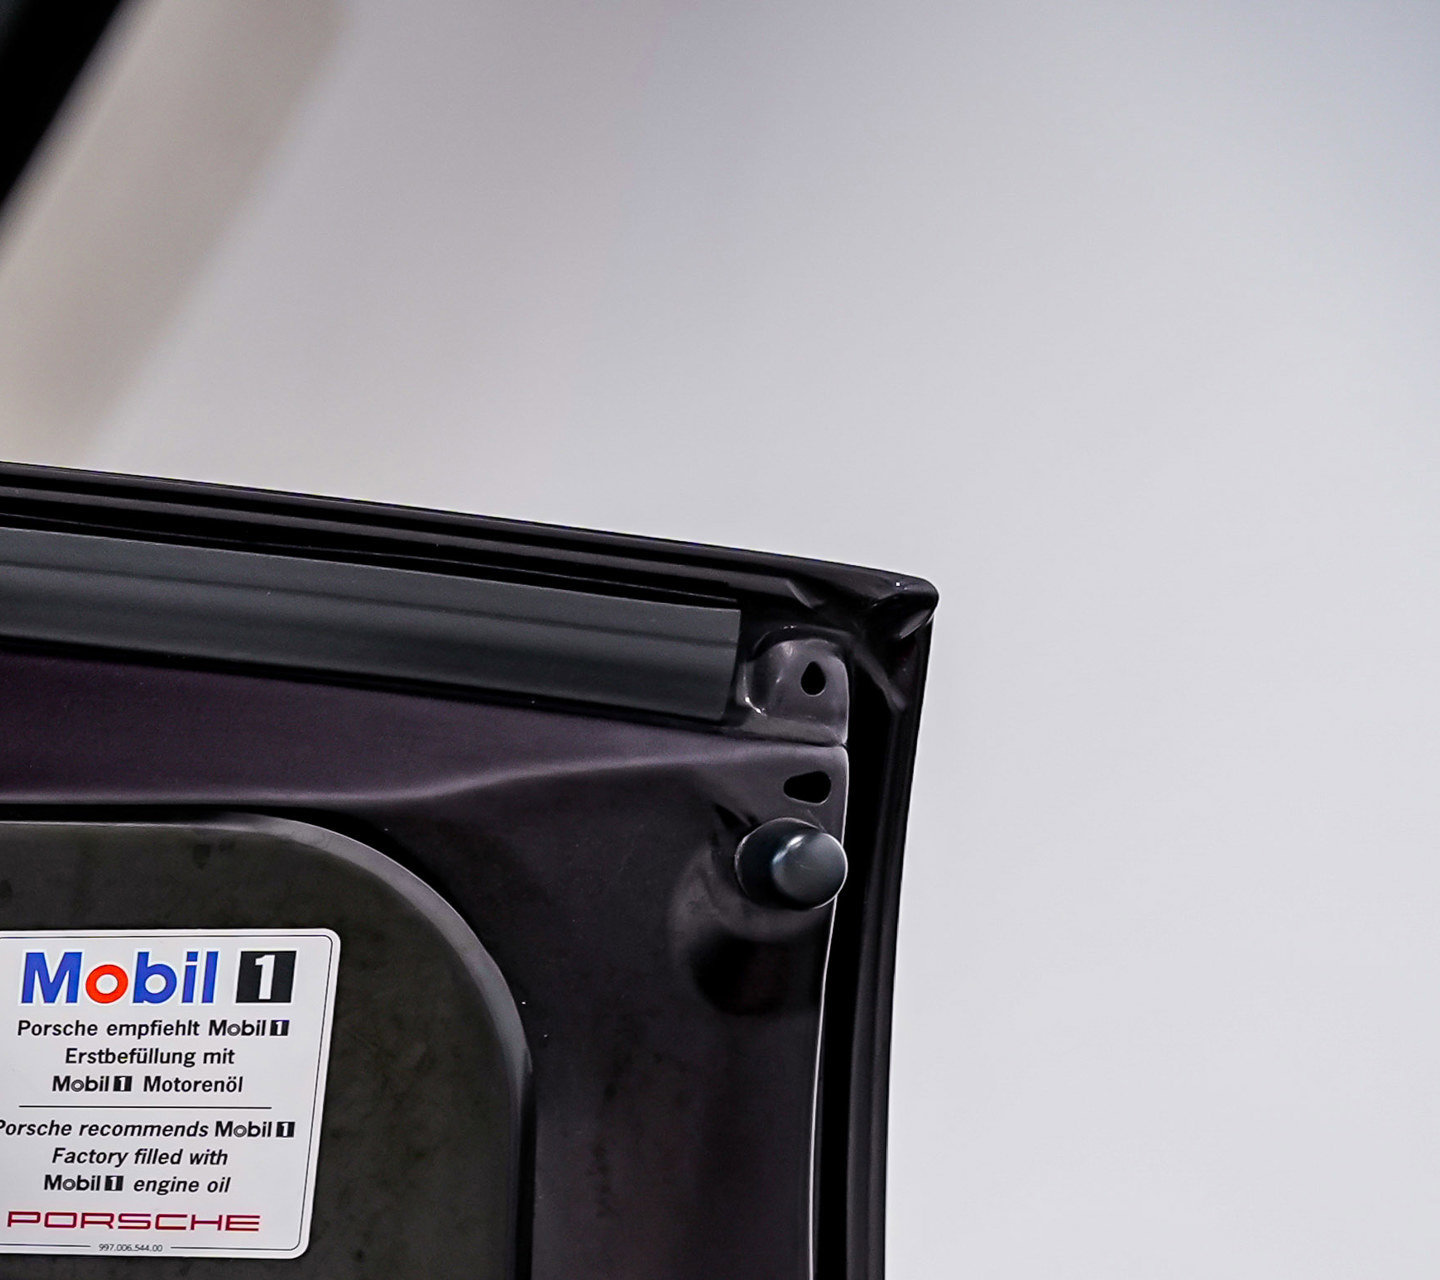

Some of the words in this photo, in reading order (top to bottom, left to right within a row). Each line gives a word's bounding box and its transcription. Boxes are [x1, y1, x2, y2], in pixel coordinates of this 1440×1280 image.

[22, 951, 218, 1004] Mobil
[18, 1020, 98, 1036] Porsche
[107, 1020, 200, 1039] empfiehlt
[209, 1020, 266, 1036] Mobil
[66, 1048, 196, 1067] Erstbefüllung
[203, 1048, 235, 1064] mit
[52, 1076, 109, 1092] Mobil
[144, 1076, 243, 1092] Motorenöl
[79, 1121, 208, 1137] recommends
[215, 1121, 272, 1137] Mobil
[52, 1148, 128, 1167] Factory
[135, 1148, 183, 1164] filled
[190, 1149, 228, 1165] with
[44, 1175, 101, 1191] Mobil
[134, 1176, 199, 1195] engine
[207, 1177, 231, 1192] oil
[7, 1211, 260, 1231] PORSCHE
[99, 1244, 163, 1252] 997.006.544.00
